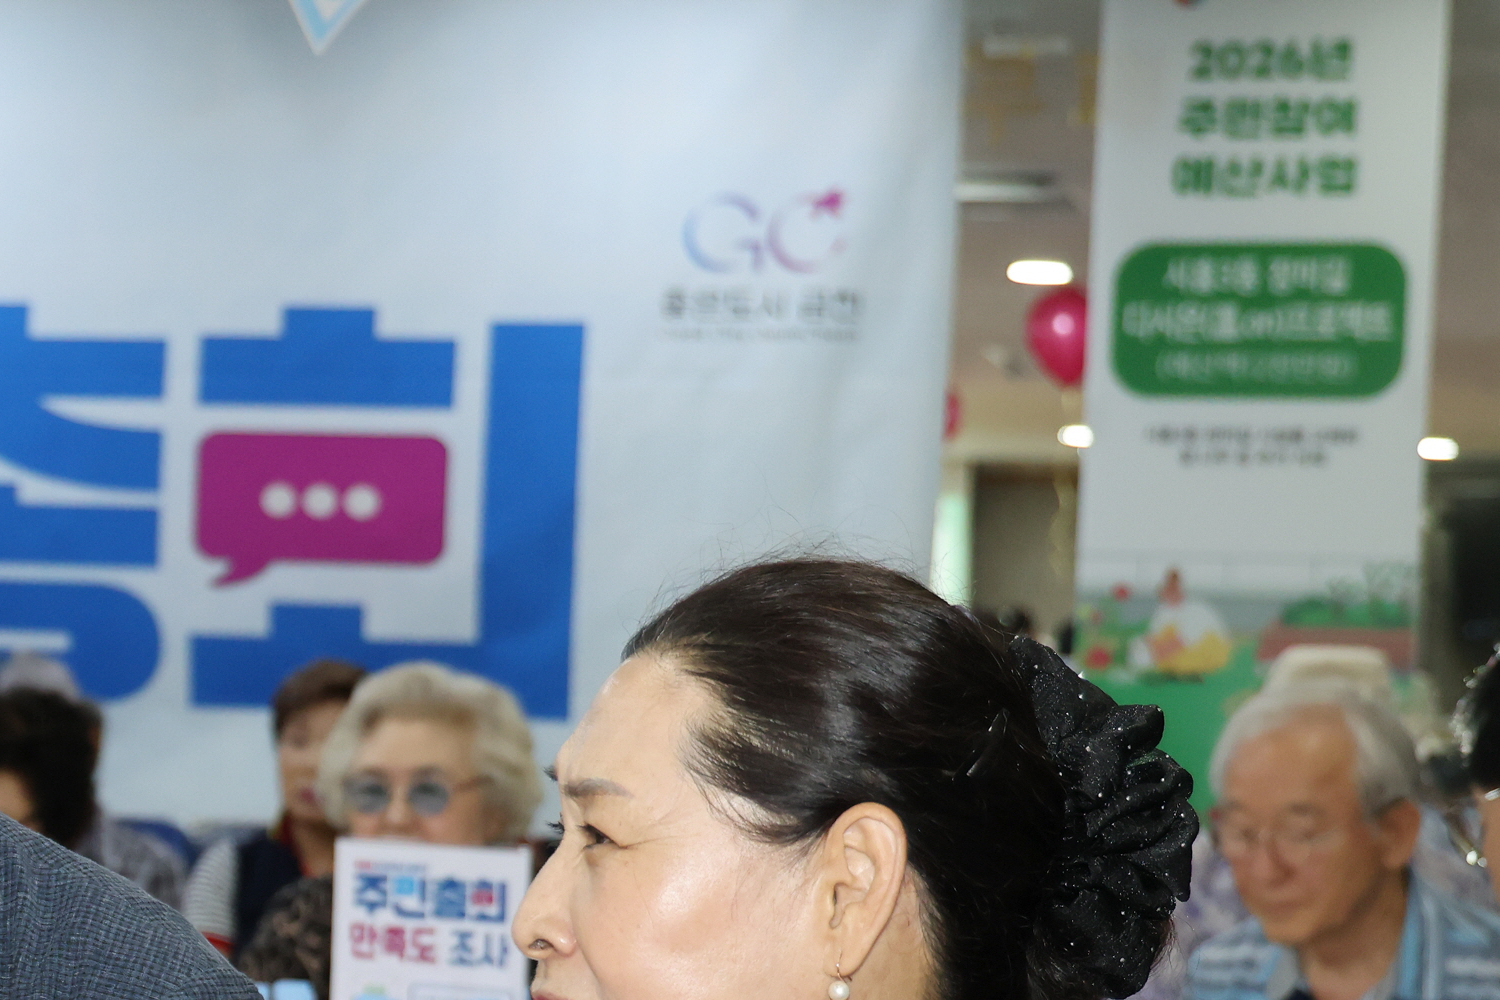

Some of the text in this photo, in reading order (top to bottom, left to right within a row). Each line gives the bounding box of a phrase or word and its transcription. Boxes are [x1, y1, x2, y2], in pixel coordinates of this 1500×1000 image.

[1188, 35, 1354, 83] 2026년
[355, 873, 506, 922] 주민총회
[350, 922, 508, 968] 만족도 조사
